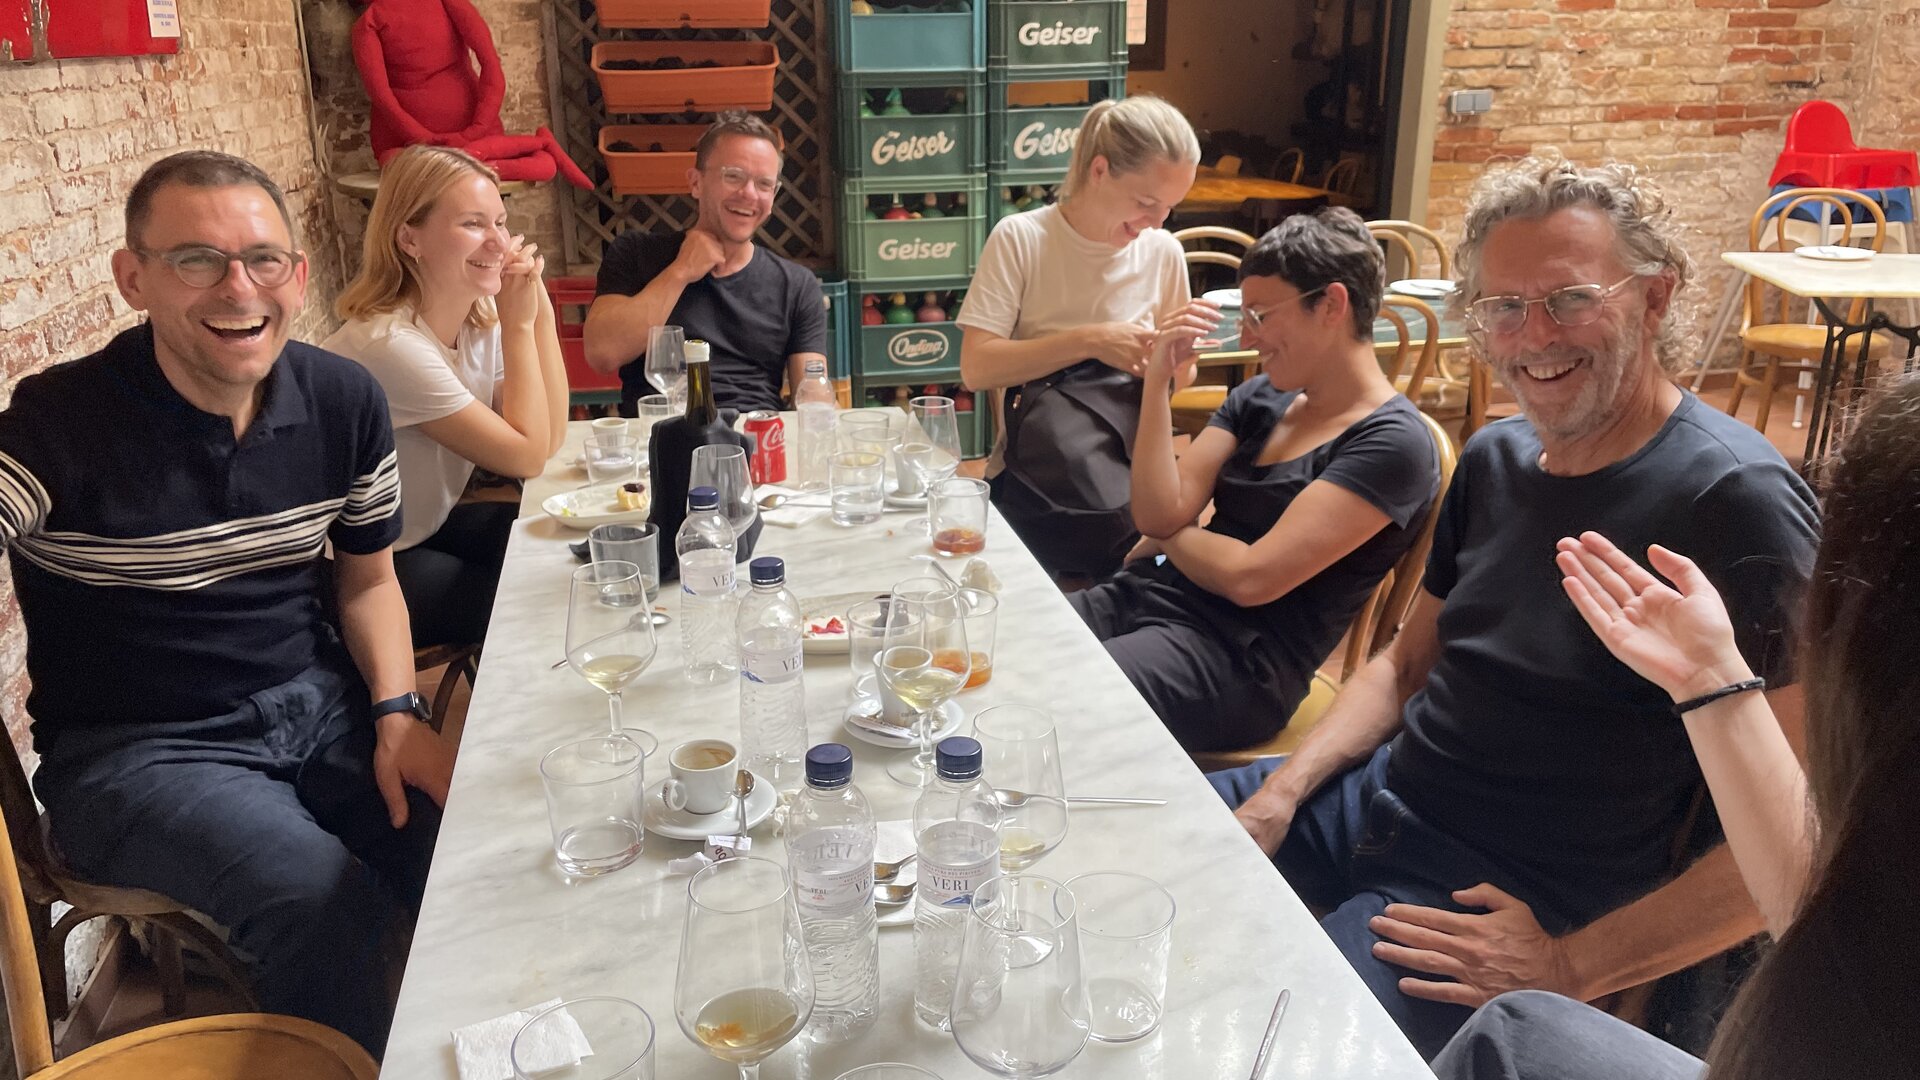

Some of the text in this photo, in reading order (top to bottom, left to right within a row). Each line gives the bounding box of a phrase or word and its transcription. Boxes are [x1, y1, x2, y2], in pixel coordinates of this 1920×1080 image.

[1018, 20, 1100, 46] Geiser
[871, 130, 955, 165] Geiser
[878, 237, 957, 261] Geiser
[932, 875, 969, 891] VERI
